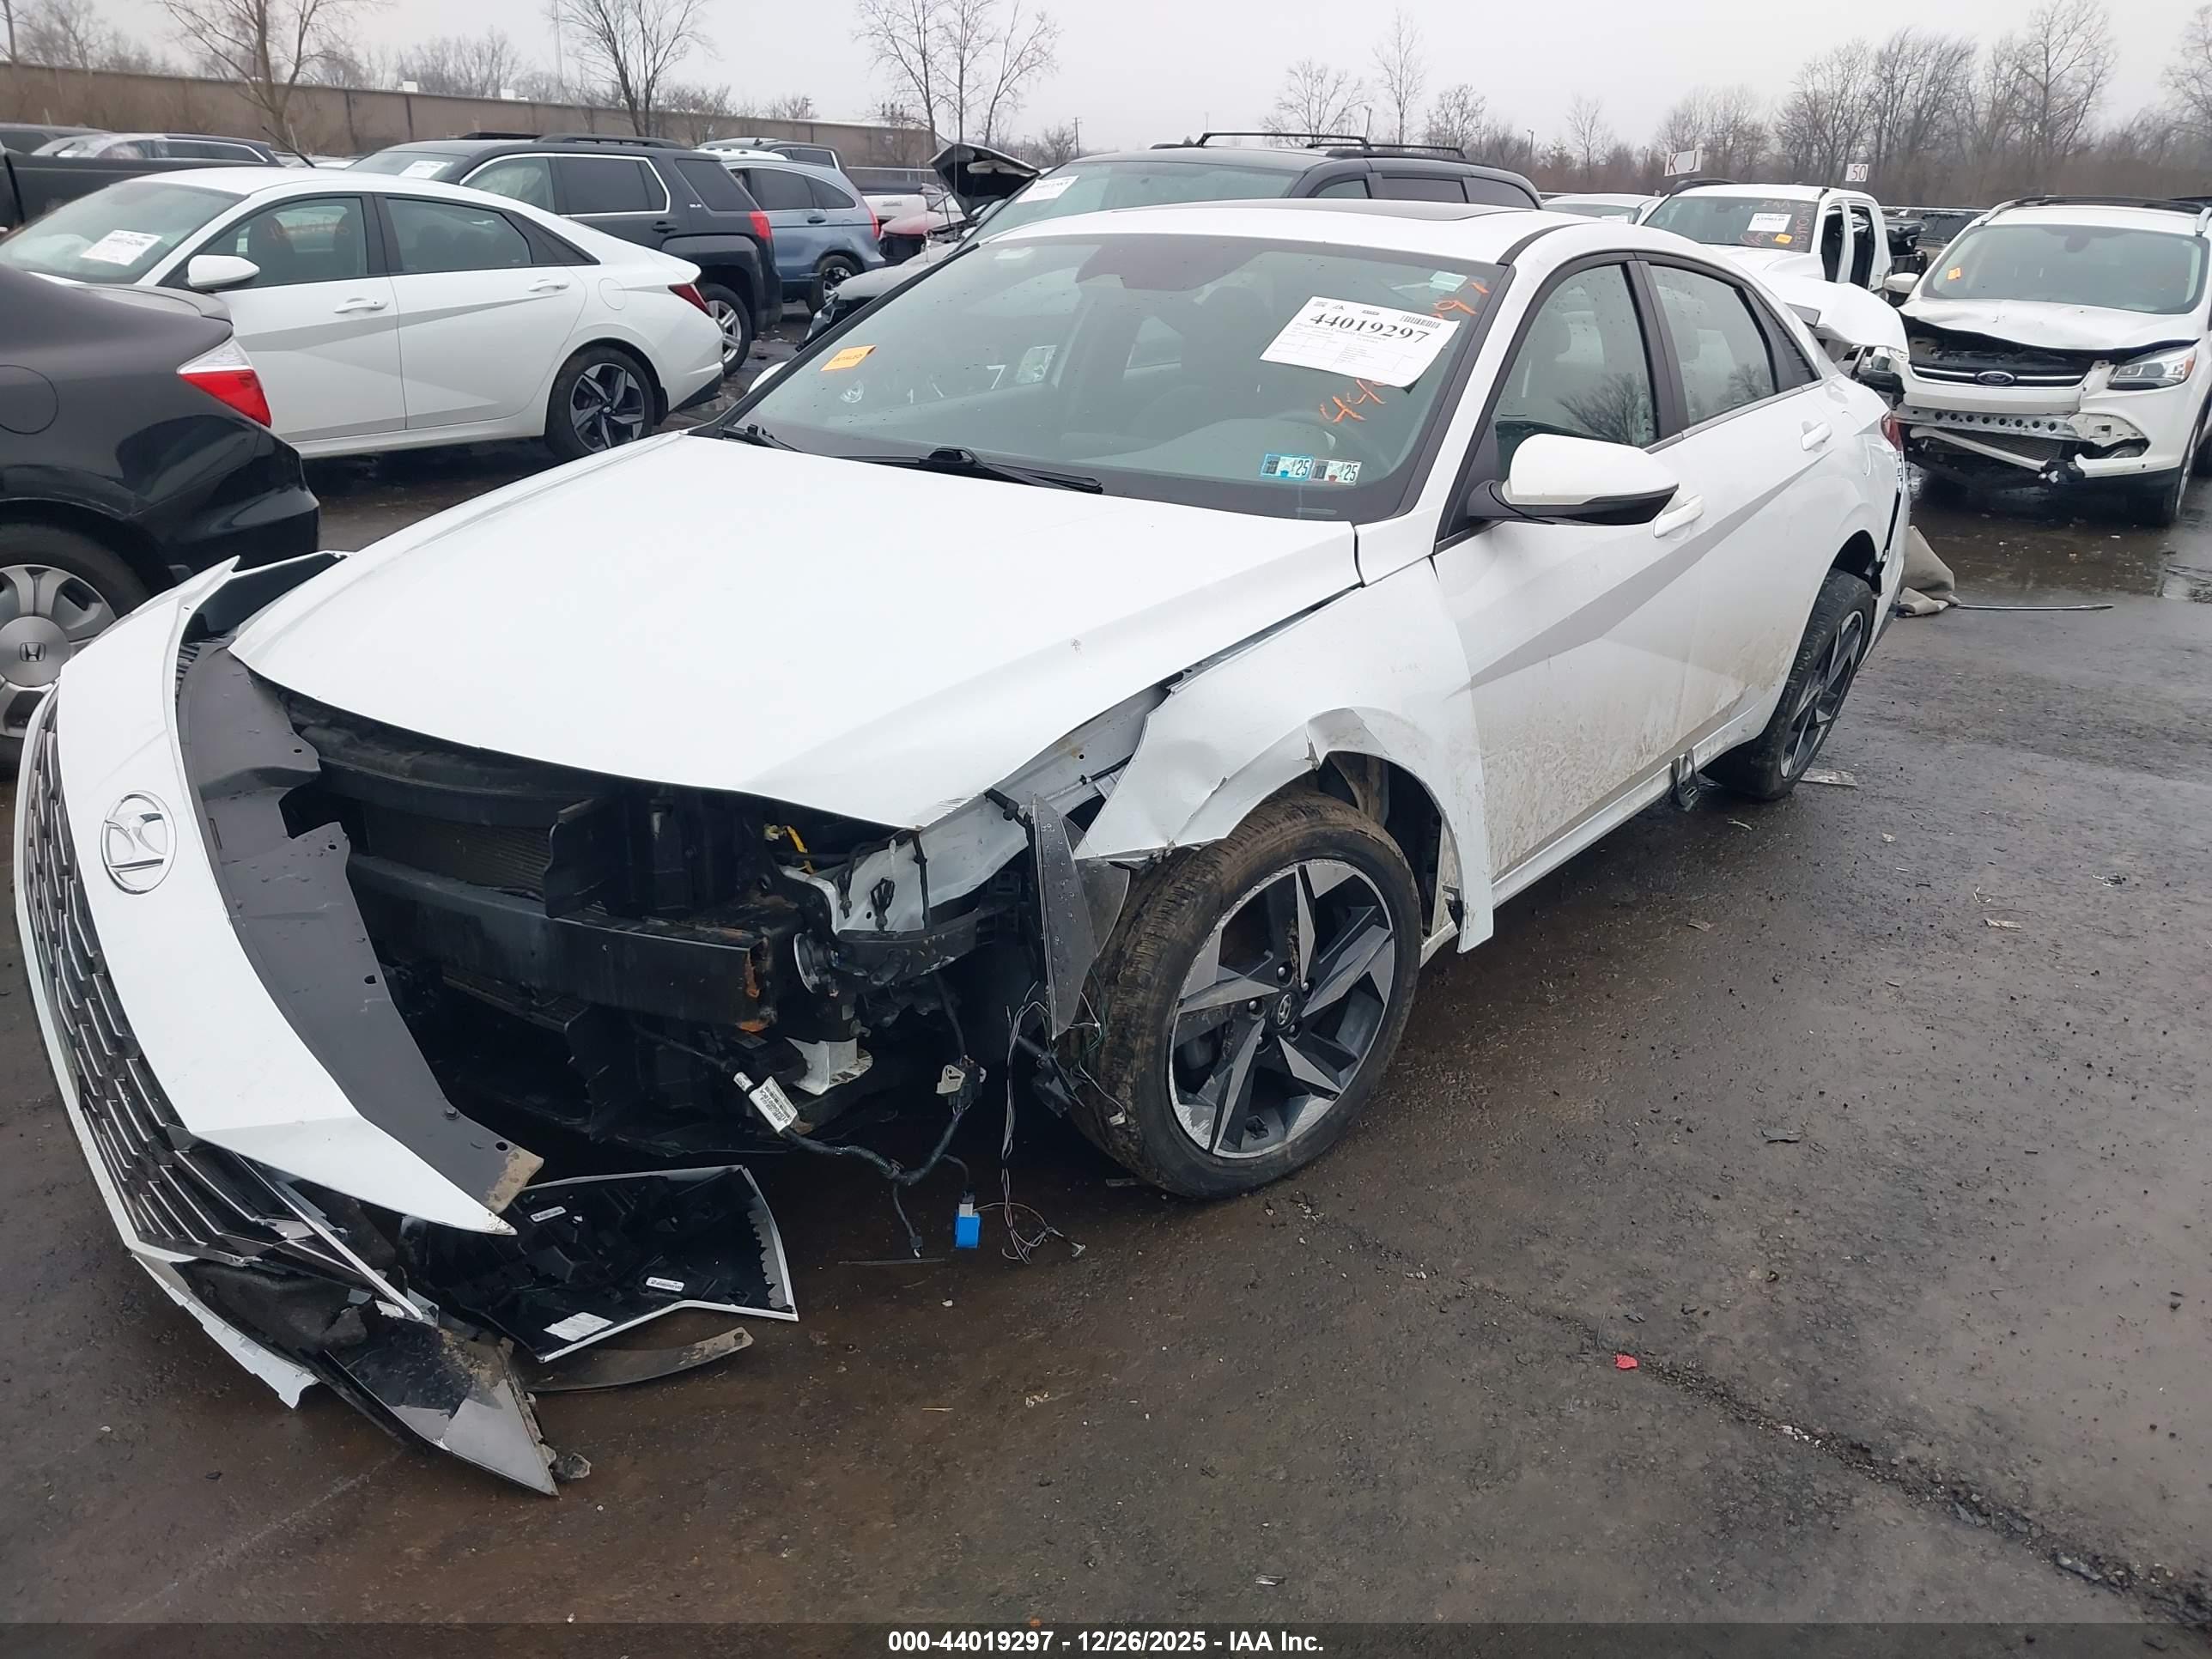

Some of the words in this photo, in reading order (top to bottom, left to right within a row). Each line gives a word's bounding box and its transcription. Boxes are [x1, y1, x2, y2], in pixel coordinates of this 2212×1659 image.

[1668, 155, 1678, 174] K
[1688, 151, 1697, 171] J
[1851, 165, 1866, 180] 50
[1309, 313, 1430, 343] 44019297
[1295, 459, 1310, 476] 25
[1344, 465, 1358, 481] 25
